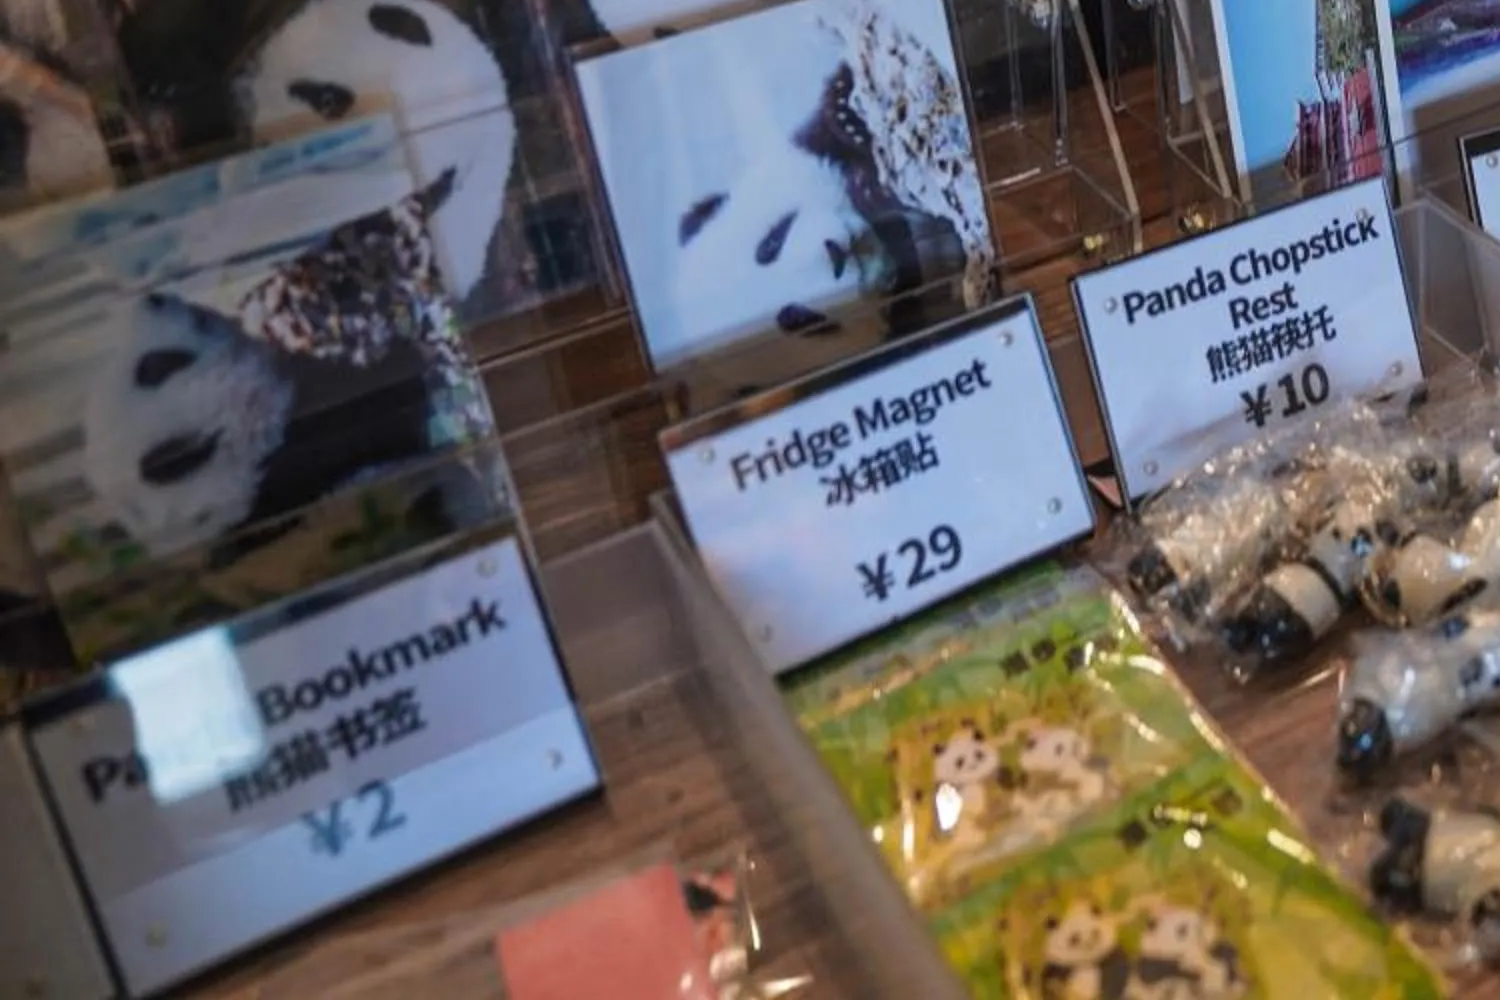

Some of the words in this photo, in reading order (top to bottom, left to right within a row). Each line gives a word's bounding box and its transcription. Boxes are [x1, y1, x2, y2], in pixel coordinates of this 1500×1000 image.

[1122, 266, 1228, 325] Panda
[1228, 212, 1381, 285] Chopstick
[1228, 281, 1300, 329] Rest
[1206, 305, 1338, 384] 熊猫筷托
[729, 419, 852, 493] Fridge
[852, 358, 993, 440] Magnet
[1239, 362, 1331, 428] ¥10
[818, 431, 941, 507] 冰箱贴
[855, 523, 964, 604] ¥29
[255, 596, 508, 727] Bookmark
[297, 777, 408, 857] ¥2
